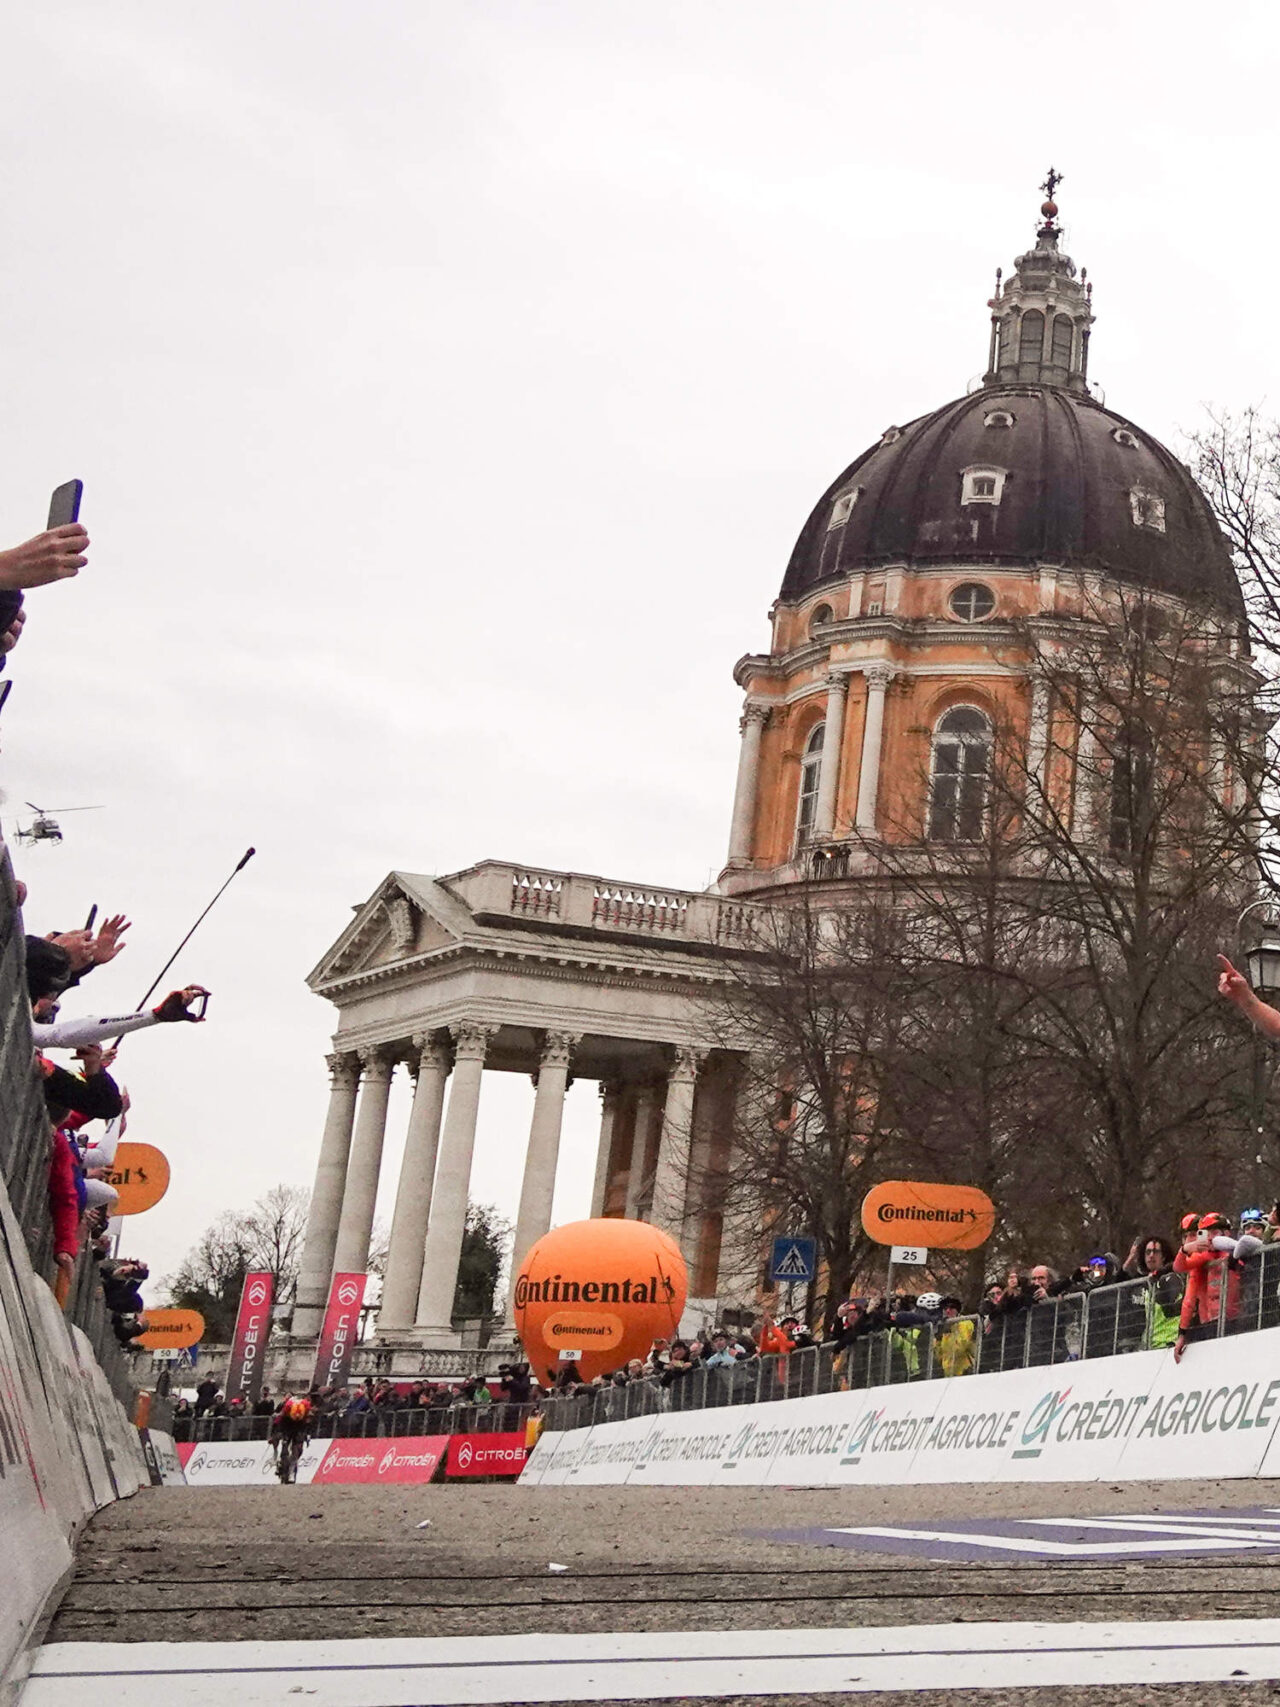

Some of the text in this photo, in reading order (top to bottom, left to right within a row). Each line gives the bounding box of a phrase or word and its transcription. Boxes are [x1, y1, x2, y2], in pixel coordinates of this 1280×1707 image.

[877, 1203, 966, 1223] Continental
[902, 1251, 918, 1261] 25
[514, 1274, 658, 1310] Continental
[552, 1323, 605, 1336] Continental
[160, 1350, 172, 1358] 50
[565, 1351, 575, 1359] 50
[1057, 1389, 1148, 1442] CRÉDIT
[871, 1410, 934, 1453] CRÉDIT
[923, 1410, 1020, 1451] AGRICOLE
